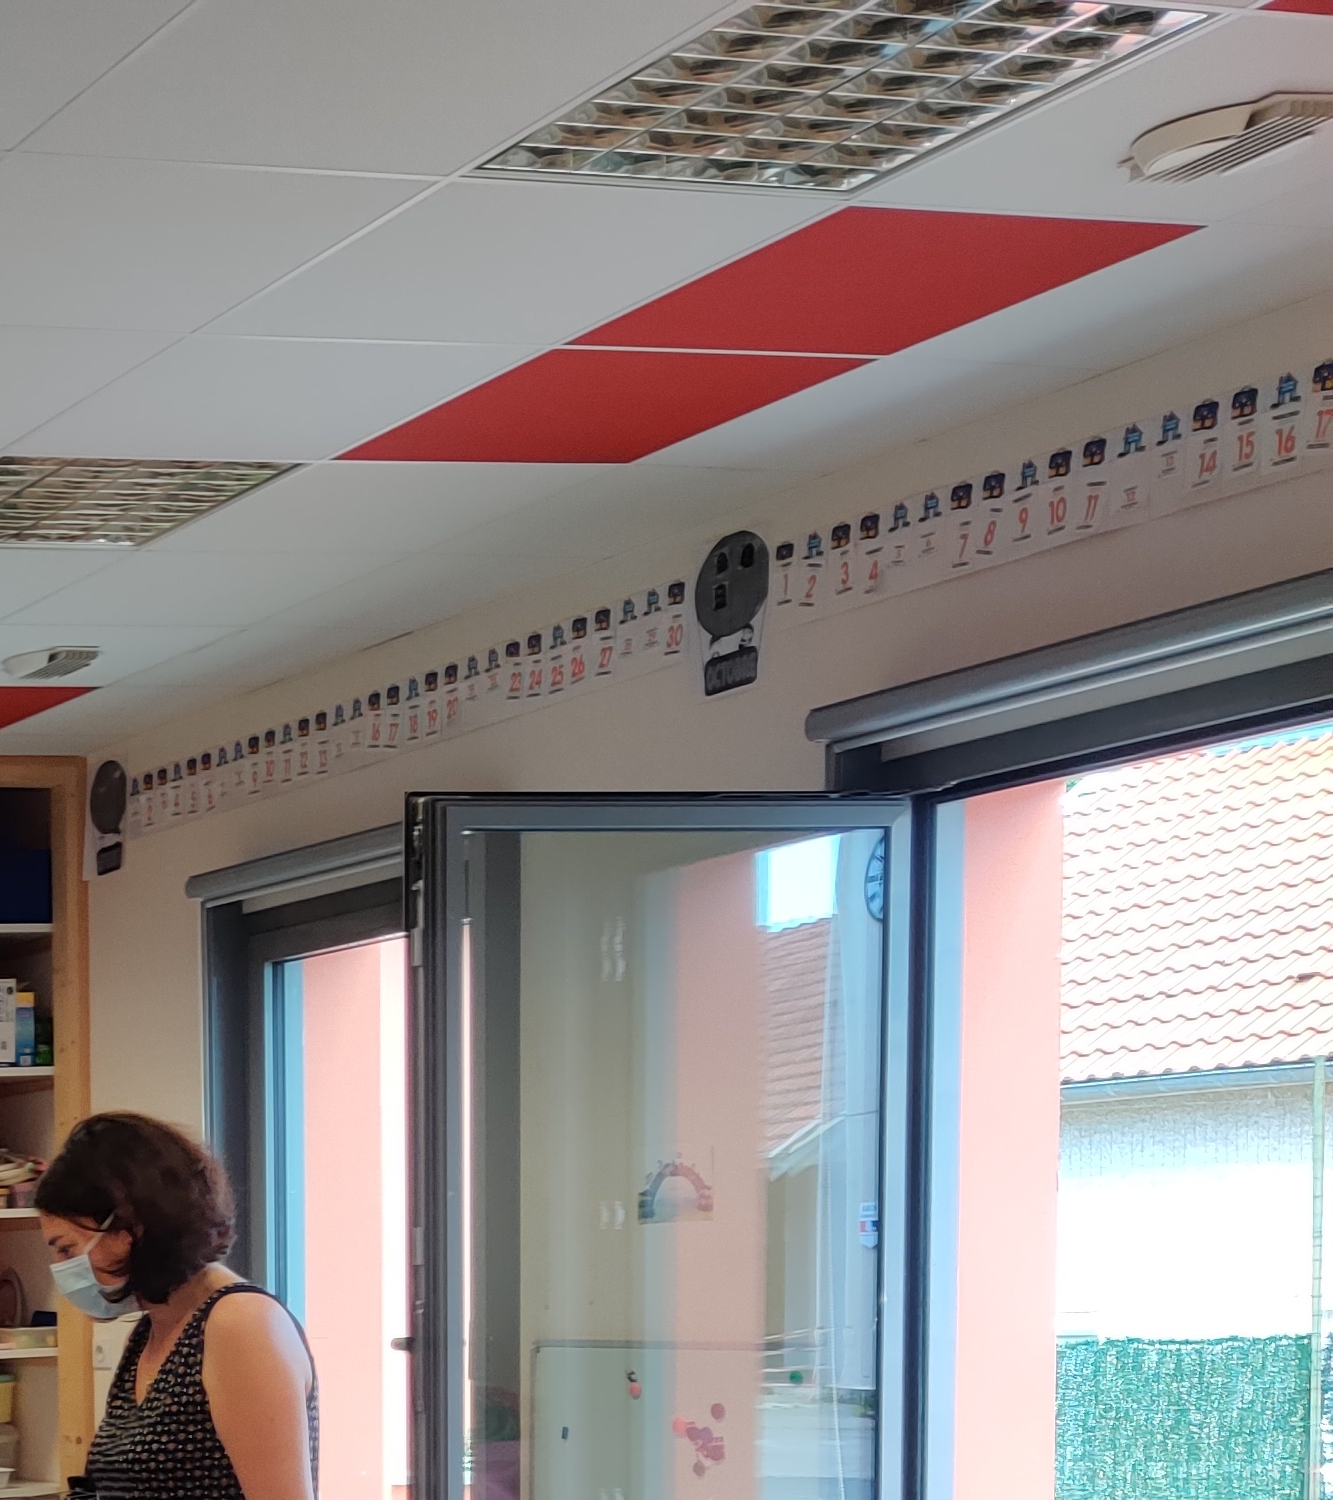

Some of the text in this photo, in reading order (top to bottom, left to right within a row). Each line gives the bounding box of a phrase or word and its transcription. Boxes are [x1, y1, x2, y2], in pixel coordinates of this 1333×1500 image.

[805, 574, 817, 598] 2
[840, 561, 850, 586] 3
[868, 560, 880, 583] 4
[958, 533, 969, 559] 7
[984, 520, 997, 546] 8
[1018, 507, 1029, 533] 9
[1048, 496, 1067, 526] 10
[1085, 493, 1100, 521] 11
[1198, 450, 1218, 479] 14
[1237, 430, 1256, 462] 15
[1275, 425, 1296, 457] 16
[427, 709, 439, 730] 19
[446, 698, 459, 720] 20
[529, 669, 543, 689] 24
[550, 665, 564, 687] 25
[570, 656, 585, 678] 26
[598, 646, 613, 669] 27
[665, 624, 682, 648] 30
